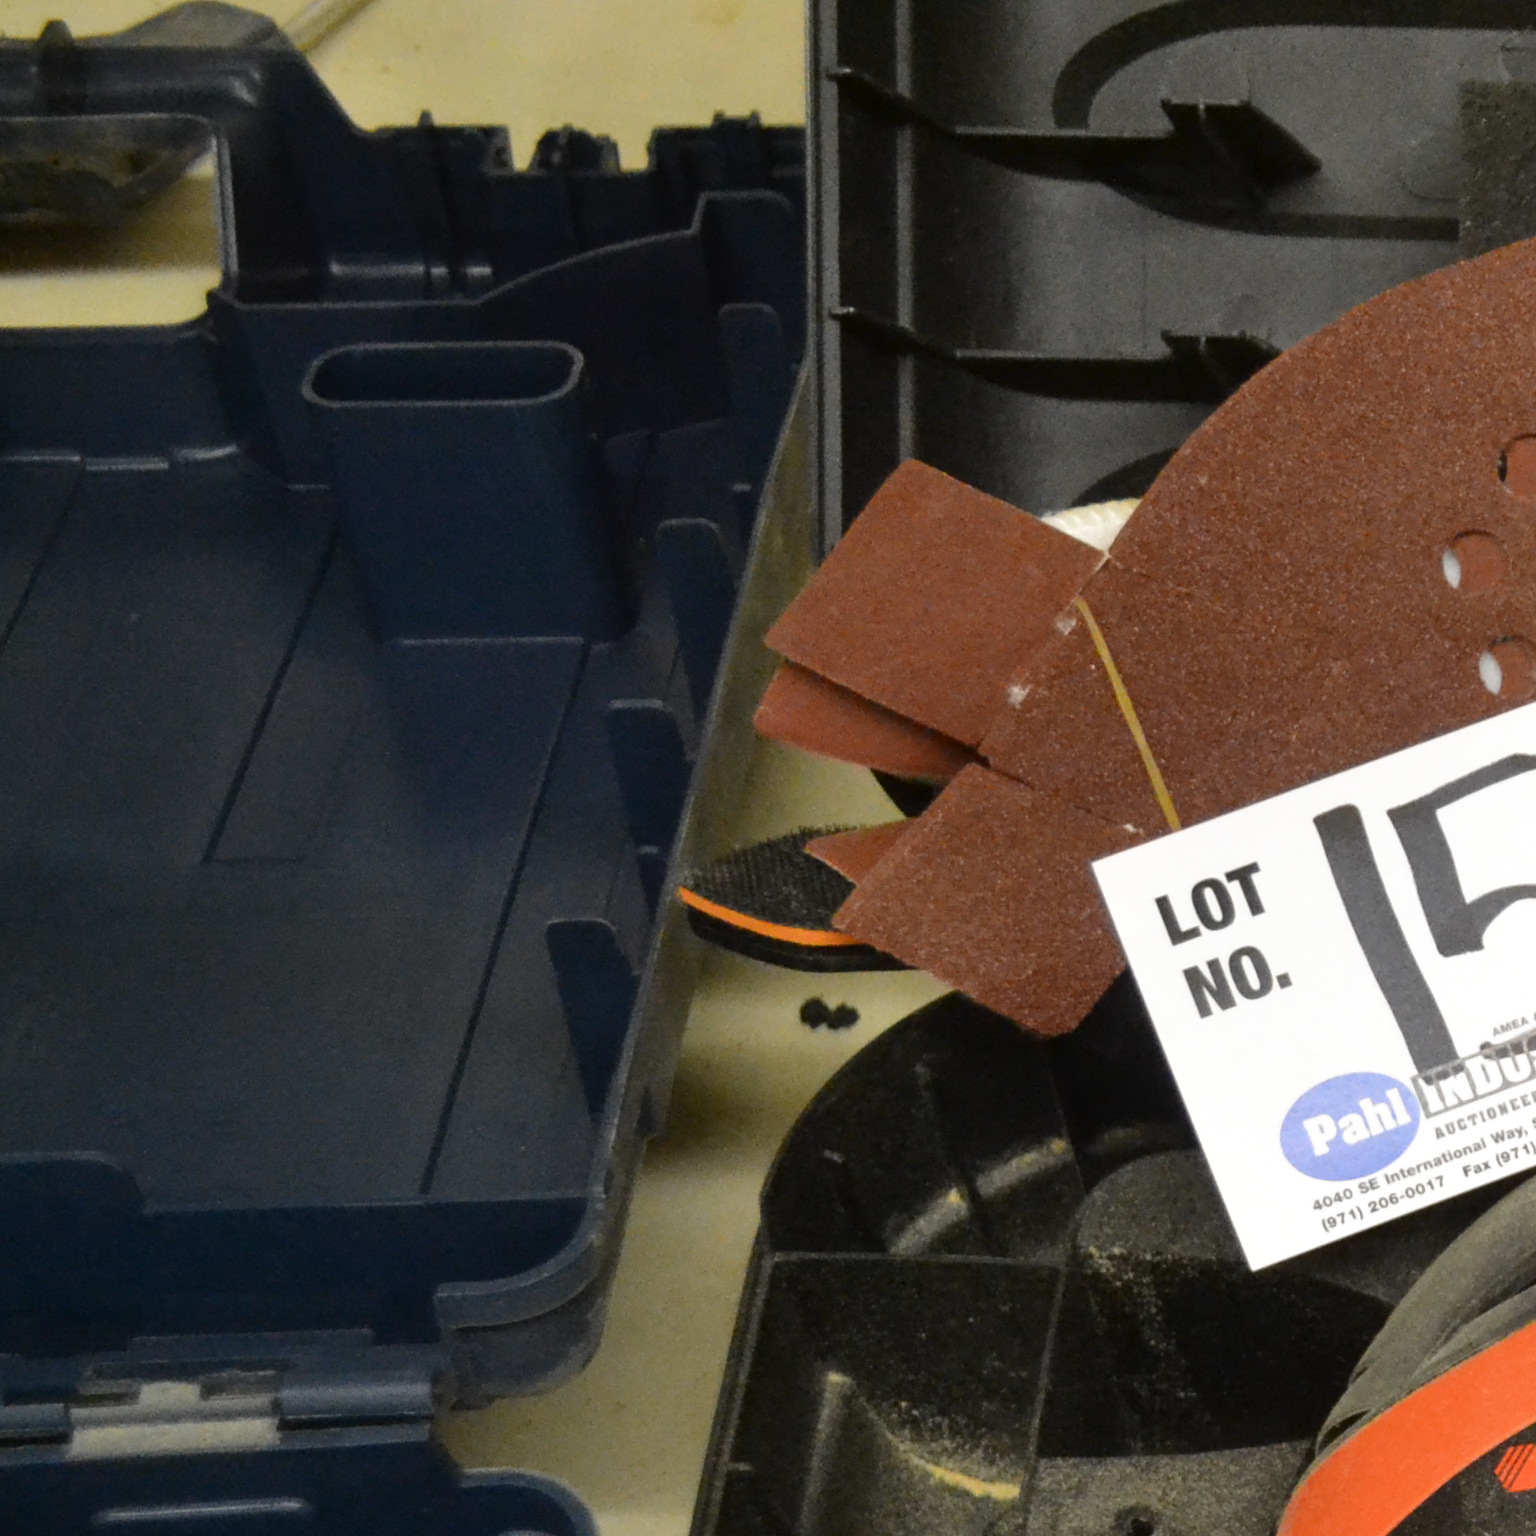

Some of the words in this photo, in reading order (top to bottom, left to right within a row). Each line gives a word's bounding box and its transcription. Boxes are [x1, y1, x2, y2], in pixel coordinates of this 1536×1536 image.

[1154, 861, 1266, 946] LOT
[1183, 945, 1293, 1019] NO.
[1493, 1016, 1529, 1036] AMEA
[1302, 1086, 1413, 1157] Pahl
[1312, 1187, 1354, 1212] 4040
[1357, 1177, 1381, 1195] SE
[1385, 1138, 1486, 1185] International
[1489, 1122, 1529, 1145] Way,
[1321, 1206, 1364, 1233] (971)
[1367, 1174, 1446, 1215] 206-0017
[1462, 1159, 1492, 1179] Fax
